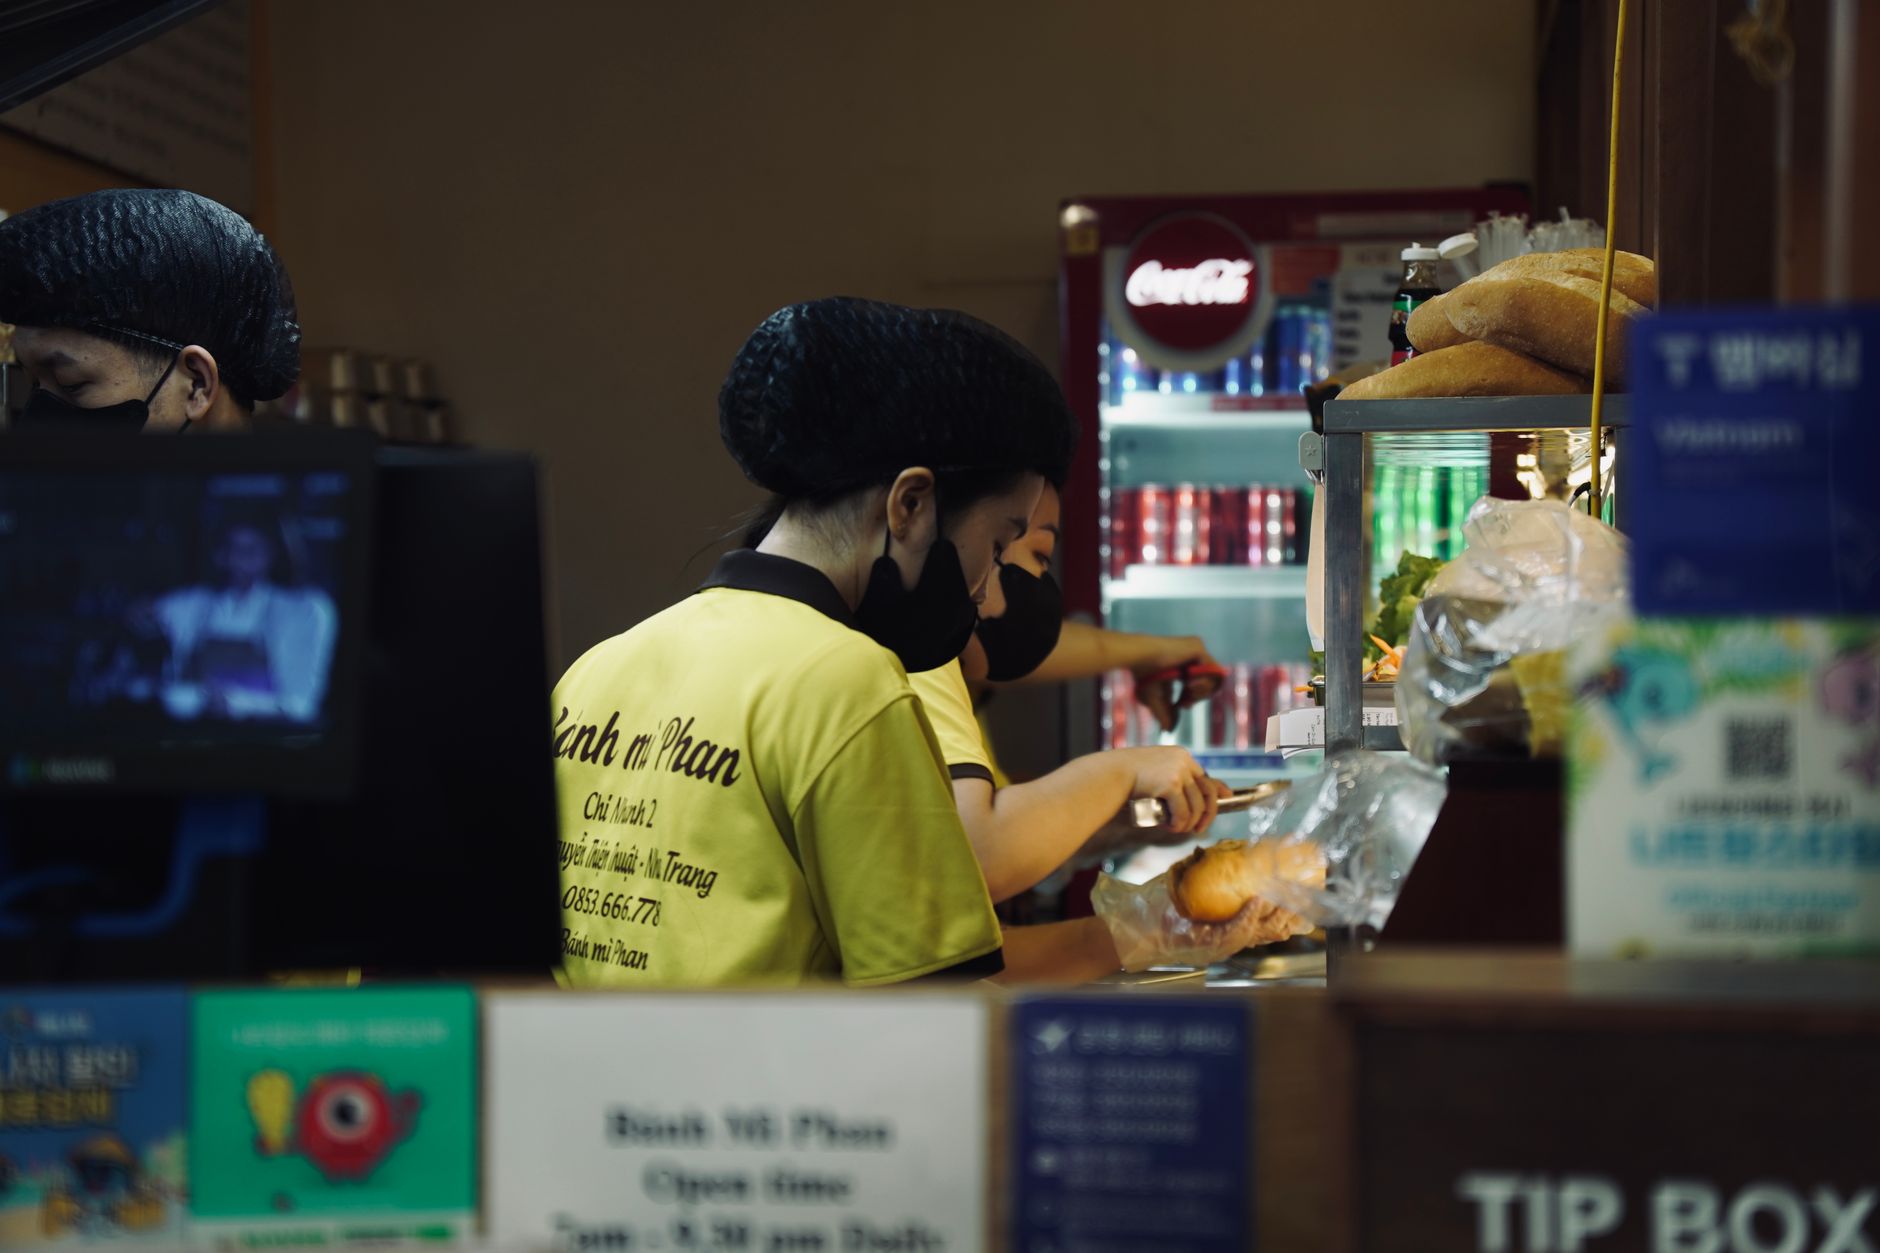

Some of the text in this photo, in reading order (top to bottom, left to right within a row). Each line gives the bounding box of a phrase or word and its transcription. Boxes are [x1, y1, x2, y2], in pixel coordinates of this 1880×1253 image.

[654, 716, 742, 788] Phan
[646, 798, 658, 829] 2
[663, 850, 719, 899] Trang
[562, 885, 662, 927] 0853.666.778
[610, 939, 649, 971] Phan
[642, 1160, 855, 1210] Open time
[1459, 1175, 1880, 1253] TIP BOX
